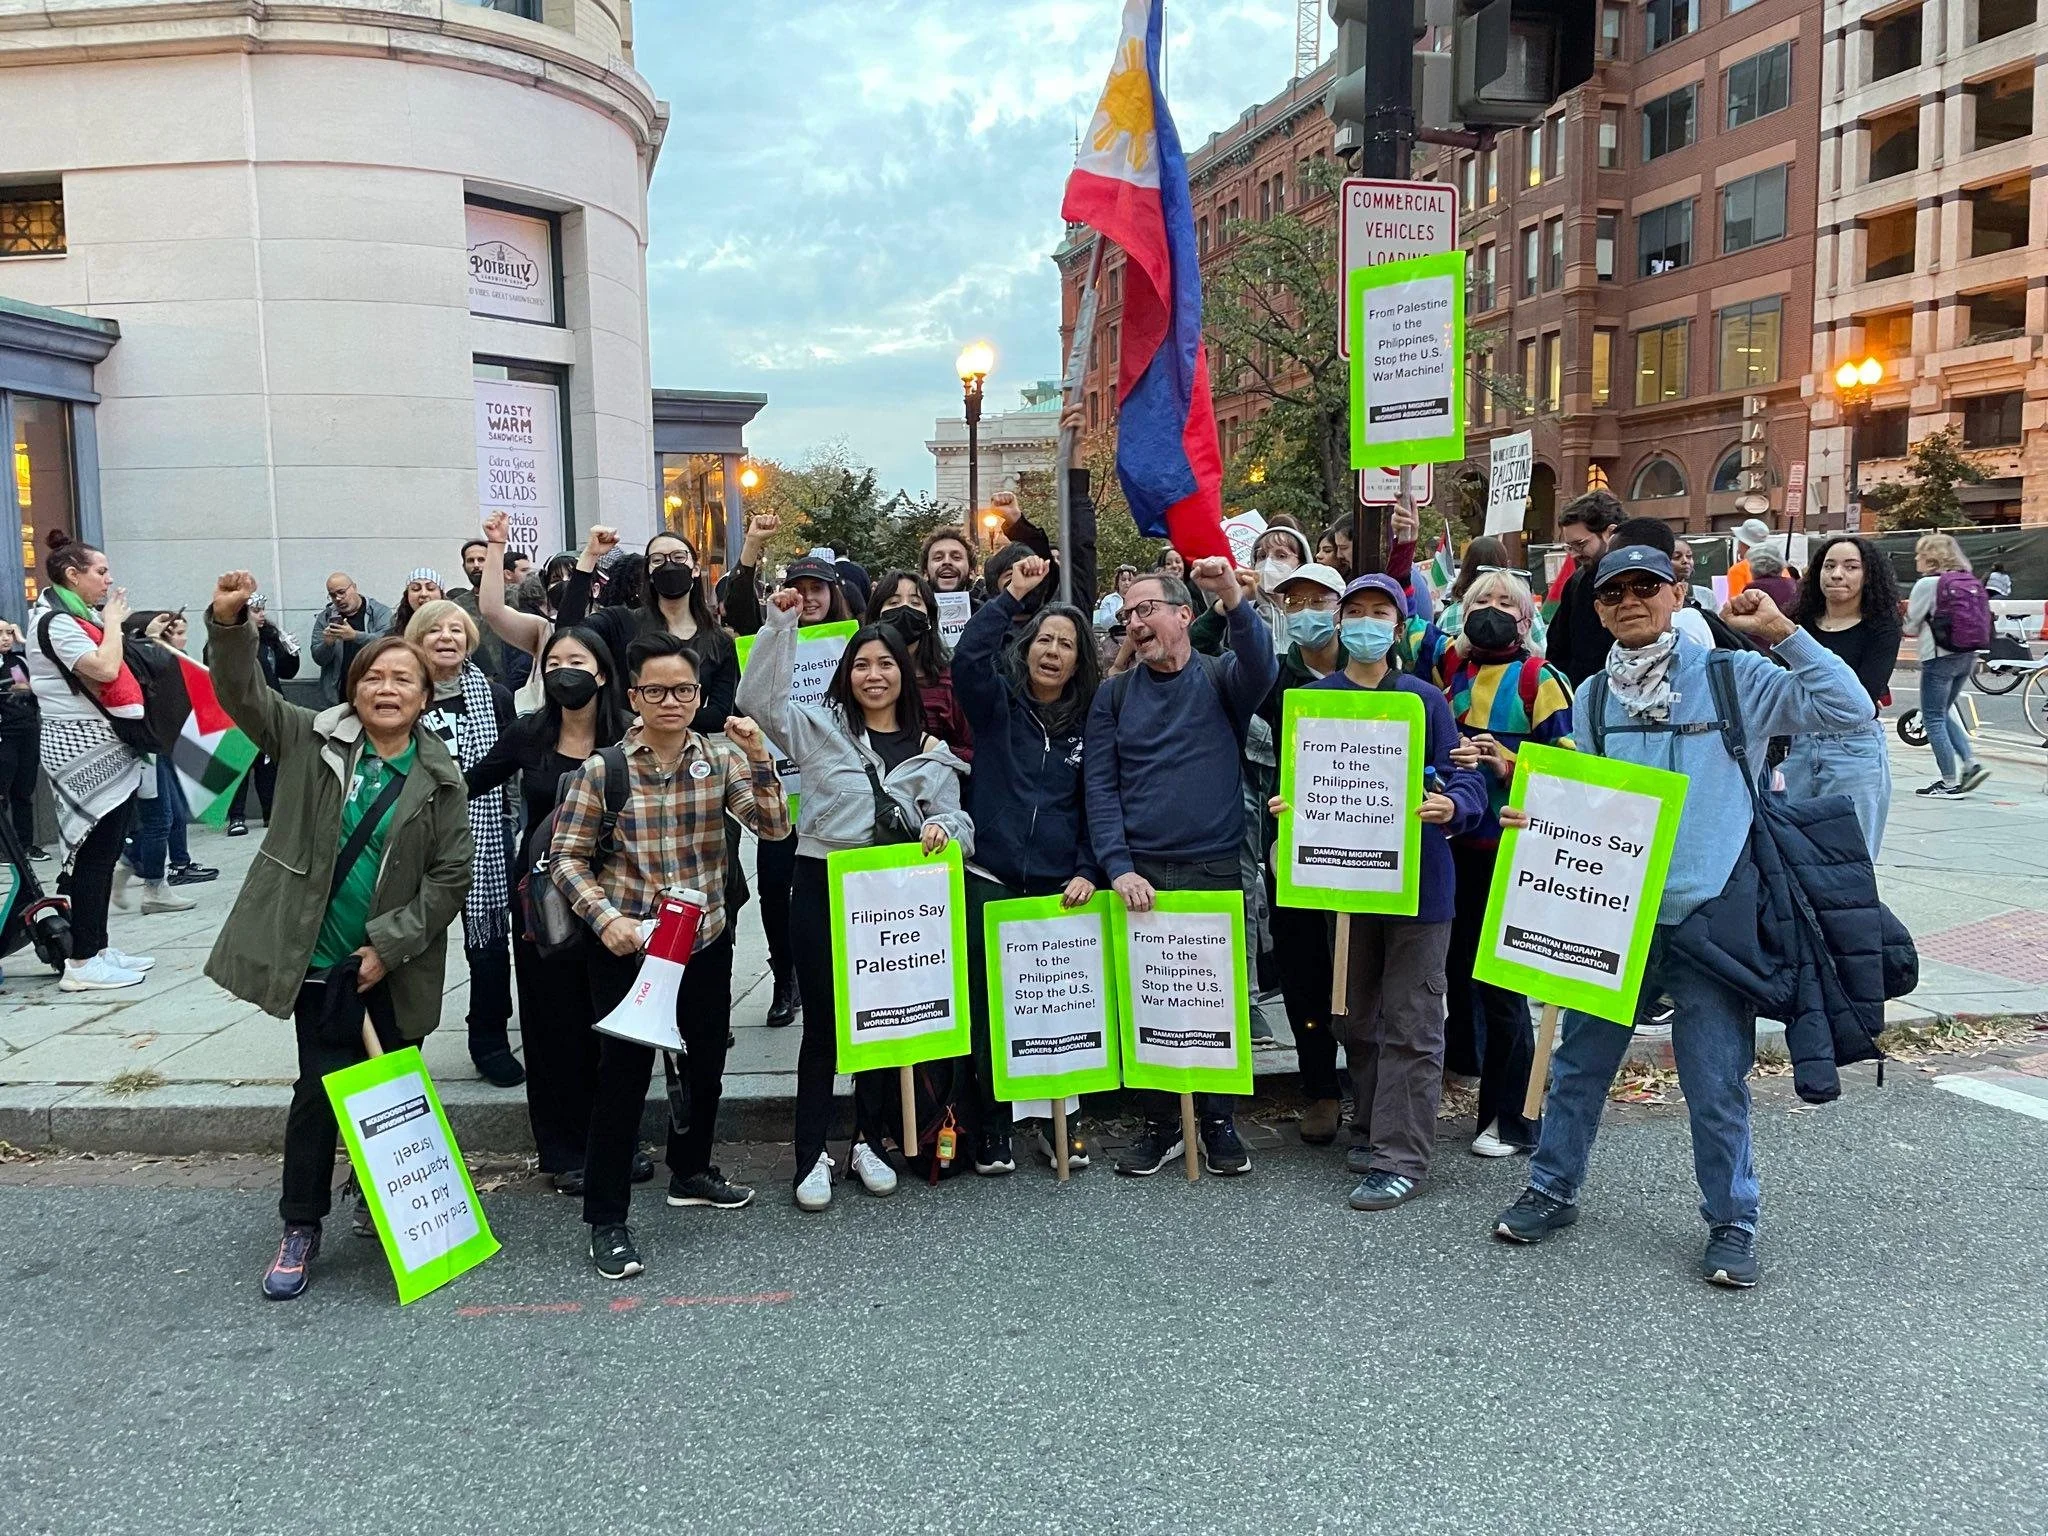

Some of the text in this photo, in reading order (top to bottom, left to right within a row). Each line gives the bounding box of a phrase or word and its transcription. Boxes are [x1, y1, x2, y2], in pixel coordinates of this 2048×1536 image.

[1353, 192, 1445, 213] COMMERCIAL
[1366, 221, 1435, 241] VEHICLES
[470, 255, 532, 282] POTBELLY
[1369, 299, 1448, 320] From Palestine
[1392, 319, 1422, 331] to the
[1378, 333, 1438, 350] Philippines,
[1374, 347, 1442, 367] Stop the U.S.
[1373, 363, 1444, 382] War Machine!
[486, 402, 532, 417] TOASTY
[1402, 407, 1443, 419] ASSOCIATION
[1408, 401, 1436, 411] MIGRANT
[487, 416, 532, 433] WARM
[488, 431, 533, 444] SANDWICHES
[1750, 397, 1767, 490] PARK
[488, 455, 535, 470] Extra Good
[489, 468, 536, 484] SOUPS &
[1492, 457, 1531, 487] PALESTINE
[490, 484, 537, 501] SALADS
[1490, 482, 1528, 506] IS FREE
[508, 512, 538, 526] okies
[793, 658, 839, 673] Palestin
[803, 677, 821, 687] the
[1303, 741, 1402, 756] From Palestine
[1333, 760, 1370, 771] to the
[1313, 775, 1389, 791] Philippines,
[1307, 792, 1393, 807] Stop the U.S.
[1305, 809, 1394, 824] War Machine!
[1528, 817, 1644, 858] Filipinos Say
[1305, 856, 1391, 867] WORKERS ASSOCIATION
[1313, 848, 1383, 859] DAMAYAN MIGRANT
[1554, 848, 1603, 875] Free
[1518, 870, 1630, 912] Palestine!
[851, 904, 946, 925] Filipinos Say
[880, 930, 921, 946] Free
[1006, 937, 1097, 953] From Palestine
[1134, 931, 1226, 945] From Palestine
[1522, 932, 1603, 958] DAMAYAN MIGRANT
[856, 949, 946, 975] Palestine!
[1035, 956, 1070, 967] to the
[1161, 950, 1198, 960] to the
[1511, 939, 1610, 970] WORKERS ASSOCIATION
[1019, 970, 1088, 984] Philippines,
[1145, 964, 1217, 978] Philippines,
[634, 982, 651, 1006] PYLE
[1015, 983, 1093, 1000] Stop the U.S.
[1142, 979, 1222, 993] Stop the U.S.
[1014, 998, 1096, 1015] War Machine!
[1141, 995, 1225, 1008] War Machine!
[870, 1002, 936, 1018] DAMAYAN MIGRANT
[863, 1010, 943, 1027] WORKERS ASSOCIATION
[1025, 1034, 1087, 1047] DAMAYAN MIGRANT
[1146, 1037, 1224, 1047] WORKERS ASSOCIATION
[1152, 1030, 1216, 1039] DAMAYAN MIGRANT
[1018, 1041, 1095, 1056] WORKERS ASSOCIATION
[393, 1136, 435, 1166] Israel!
[387, 1155, 450, 1197] Apartheid
[412, 1183, 450, 1210] Aid to
[404, 1200, 468, 1241] End All U.S.
